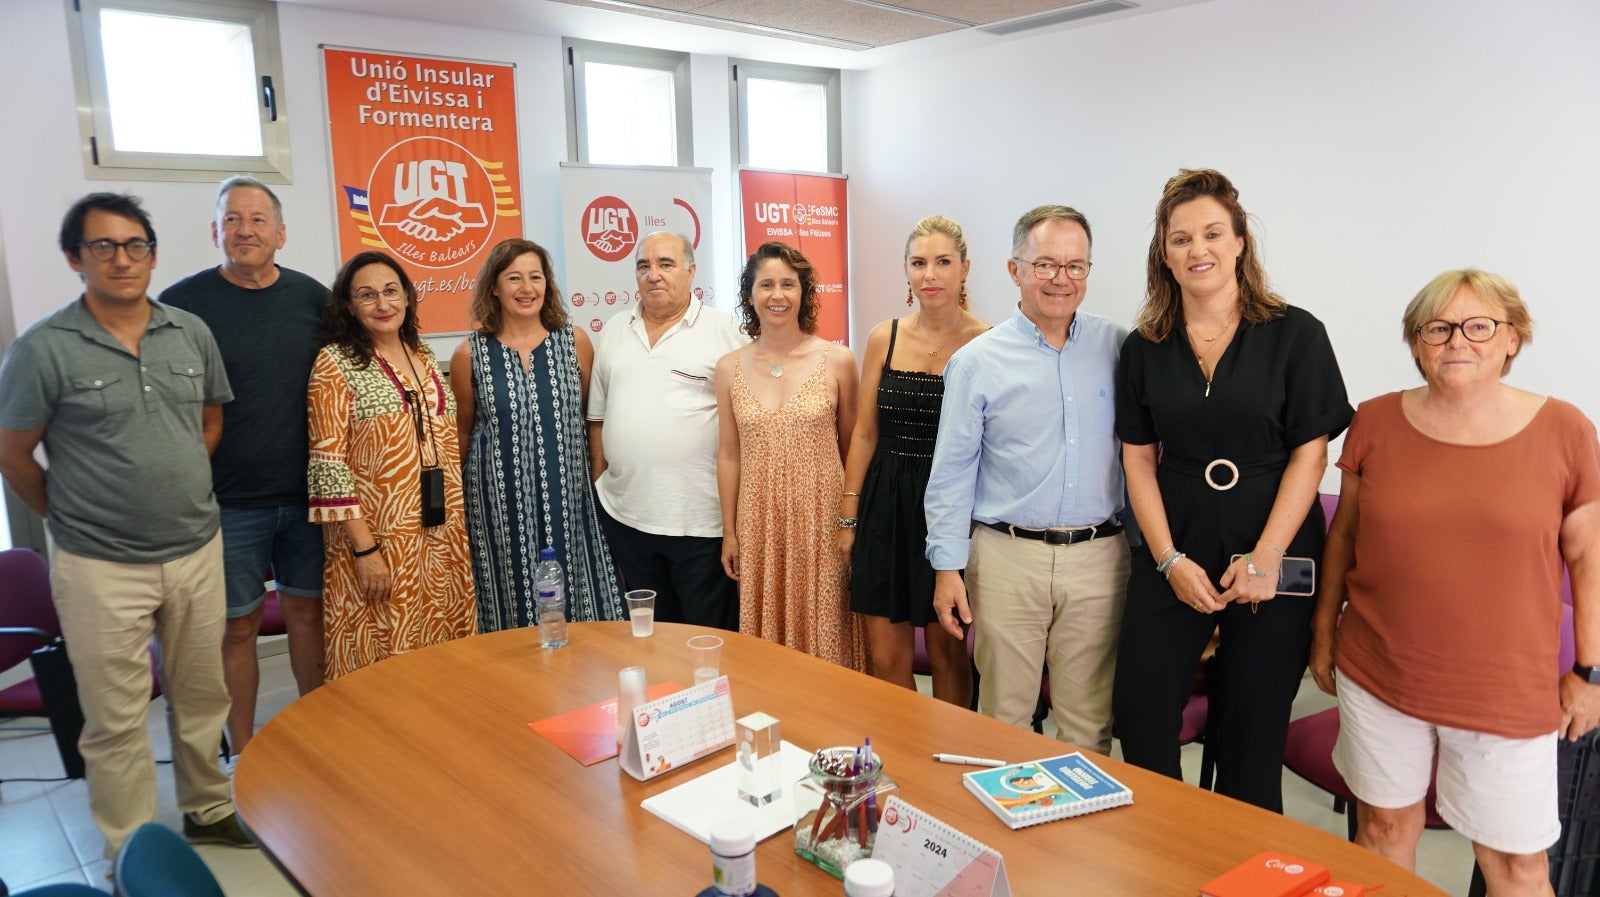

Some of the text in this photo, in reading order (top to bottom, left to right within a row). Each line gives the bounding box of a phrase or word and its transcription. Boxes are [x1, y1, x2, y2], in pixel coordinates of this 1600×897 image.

[351, 57, 495, 88] Unió Insular
[477, 91, 483, 109] i
[359, 105, 494, 132] Formentera
[394, 159, 468, 204] UGT
[589, 207, 630, 233] UGT
[645, 216, 666, 227] Illes
[754, 202, 790, 224] UGT
[811, 205, 839, 217] FeSMC
[766, 227, 793, 237] EIVISSA
[396, 239, 476, 262] Illes Balears
[923, 838, 948, 859] 2024
